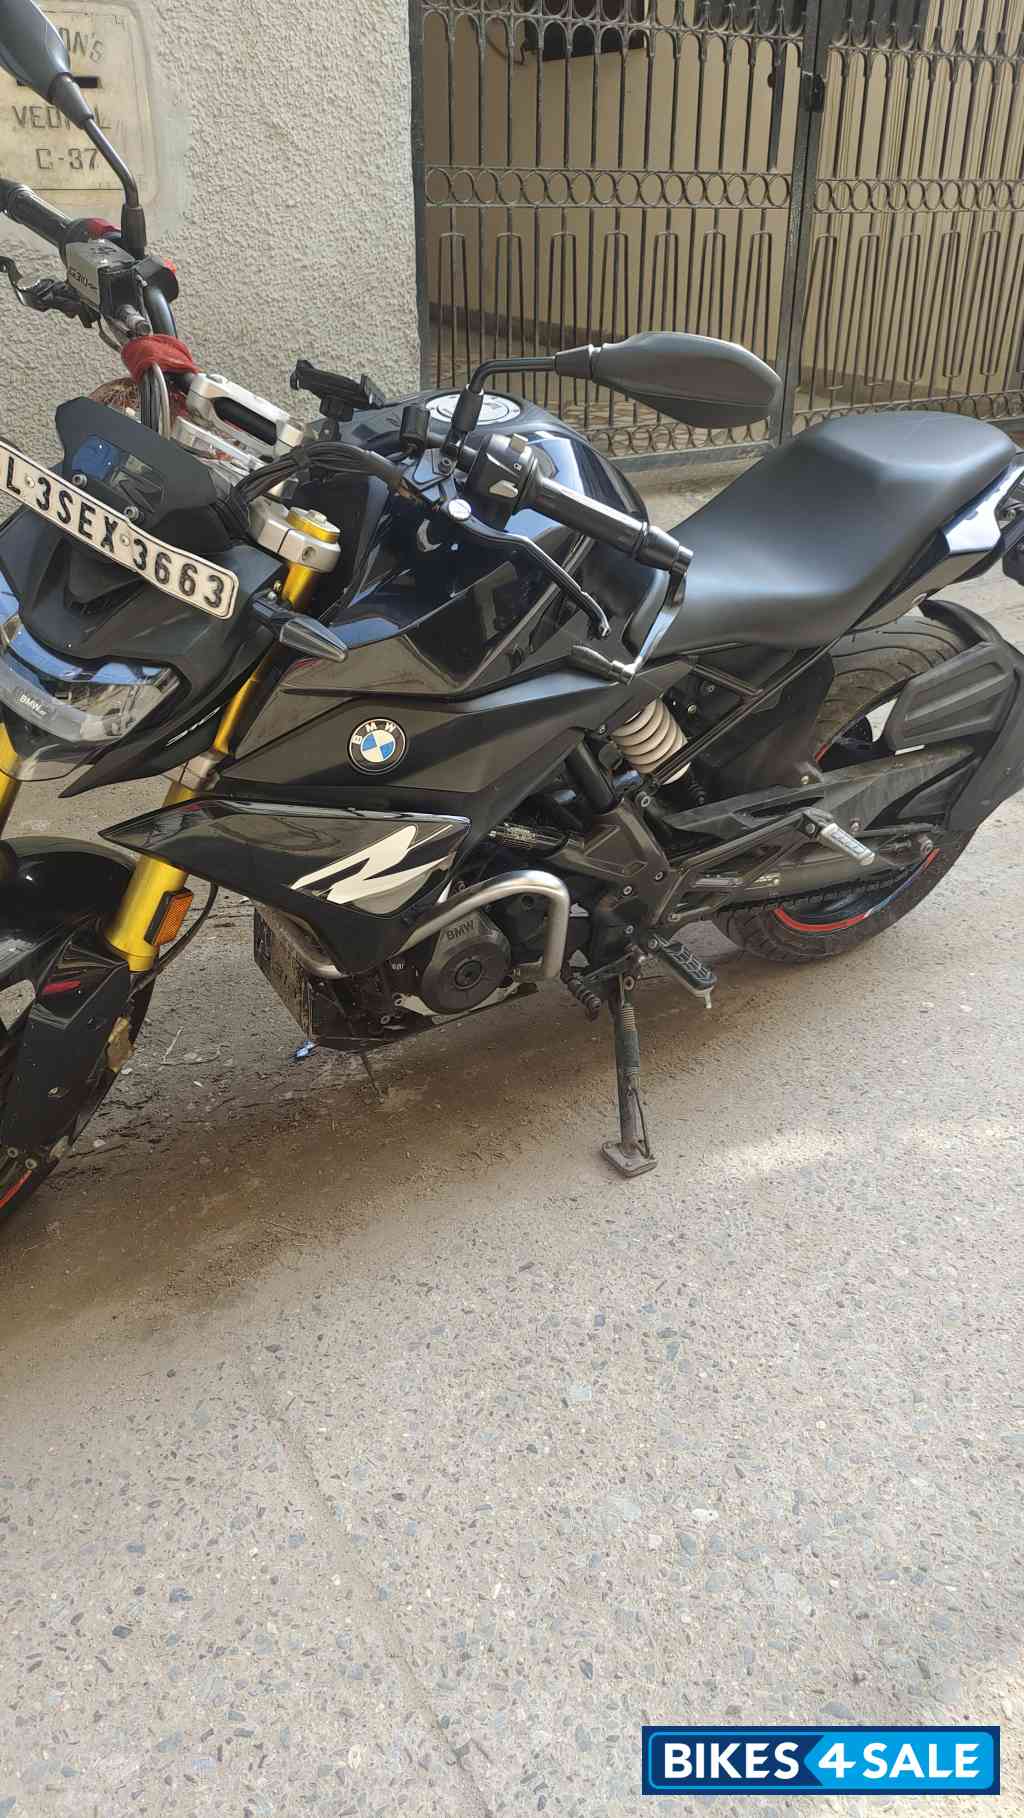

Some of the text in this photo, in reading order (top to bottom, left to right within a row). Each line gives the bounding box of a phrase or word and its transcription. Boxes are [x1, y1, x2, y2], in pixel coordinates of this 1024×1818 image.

[36, 147, 98, 170] C-37
[36, 476, 118, 553] 3SEX
[132, 538, 225, 608] 3663
[446, 920, 475, 940] BMW
